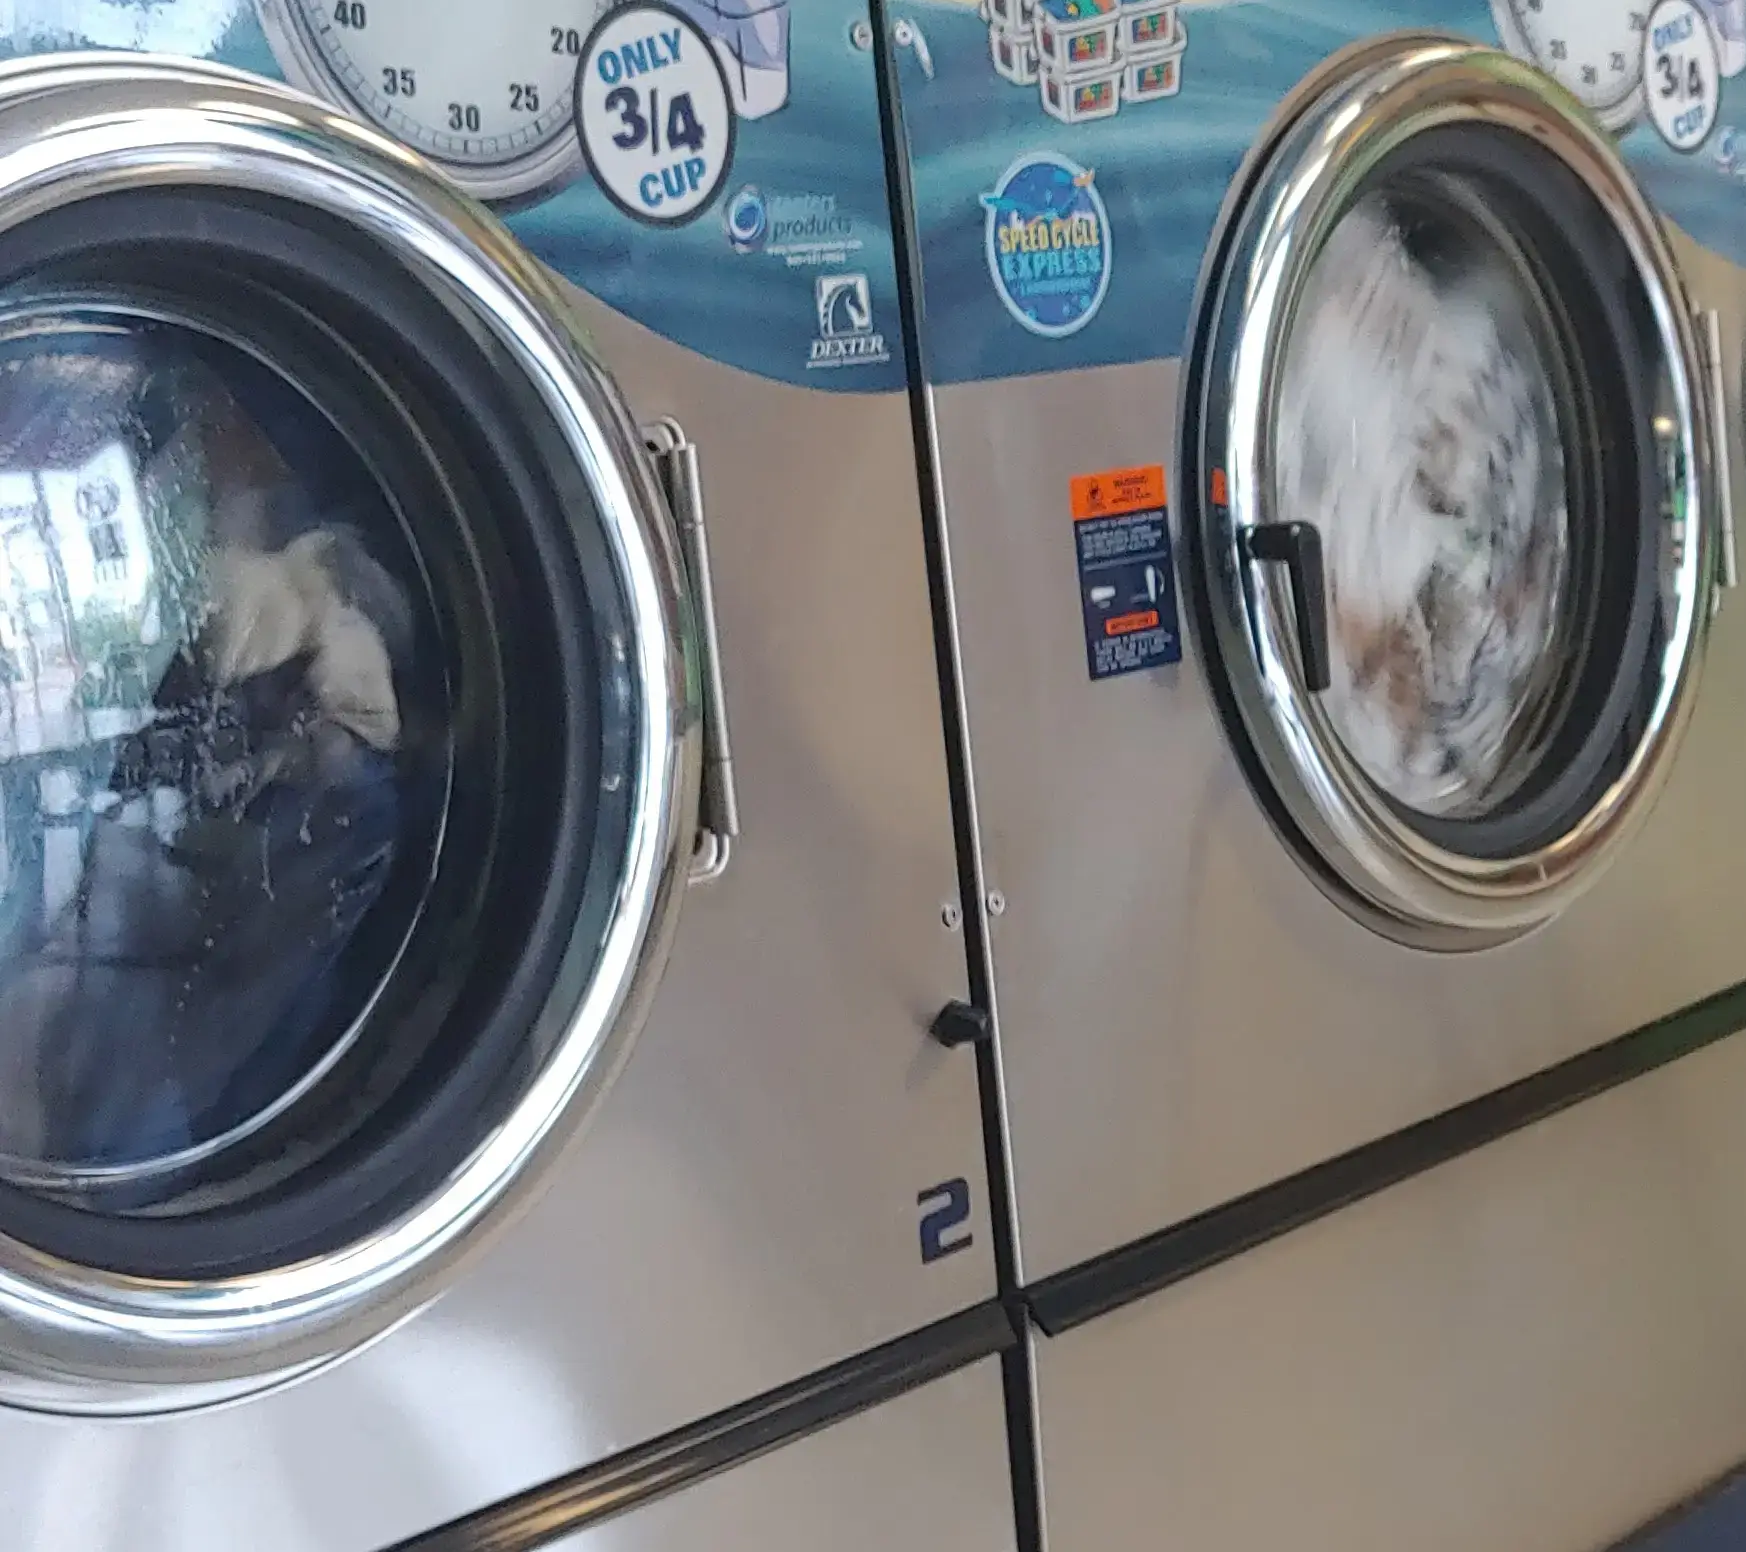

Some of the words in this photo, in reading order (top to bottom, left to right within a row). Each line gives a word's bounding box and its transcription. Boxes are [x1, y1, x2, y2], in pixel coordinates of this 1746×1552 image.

[550, 26, 582, 58] 20
[597, 26, 684, 86] ONLY
[381, 66, 417, 99] 35
[509, 81, 540, 112] 25
[447, 102, 482, 134] 30
[638, 156, 708, 209] CUP
[998, 222, 1050, 254] SPEED
[1001, 247, 1102, 282] EXPRESS
[811, 334, 886, 360] DEXTER
[916, 1176, 974, 1265] 2
